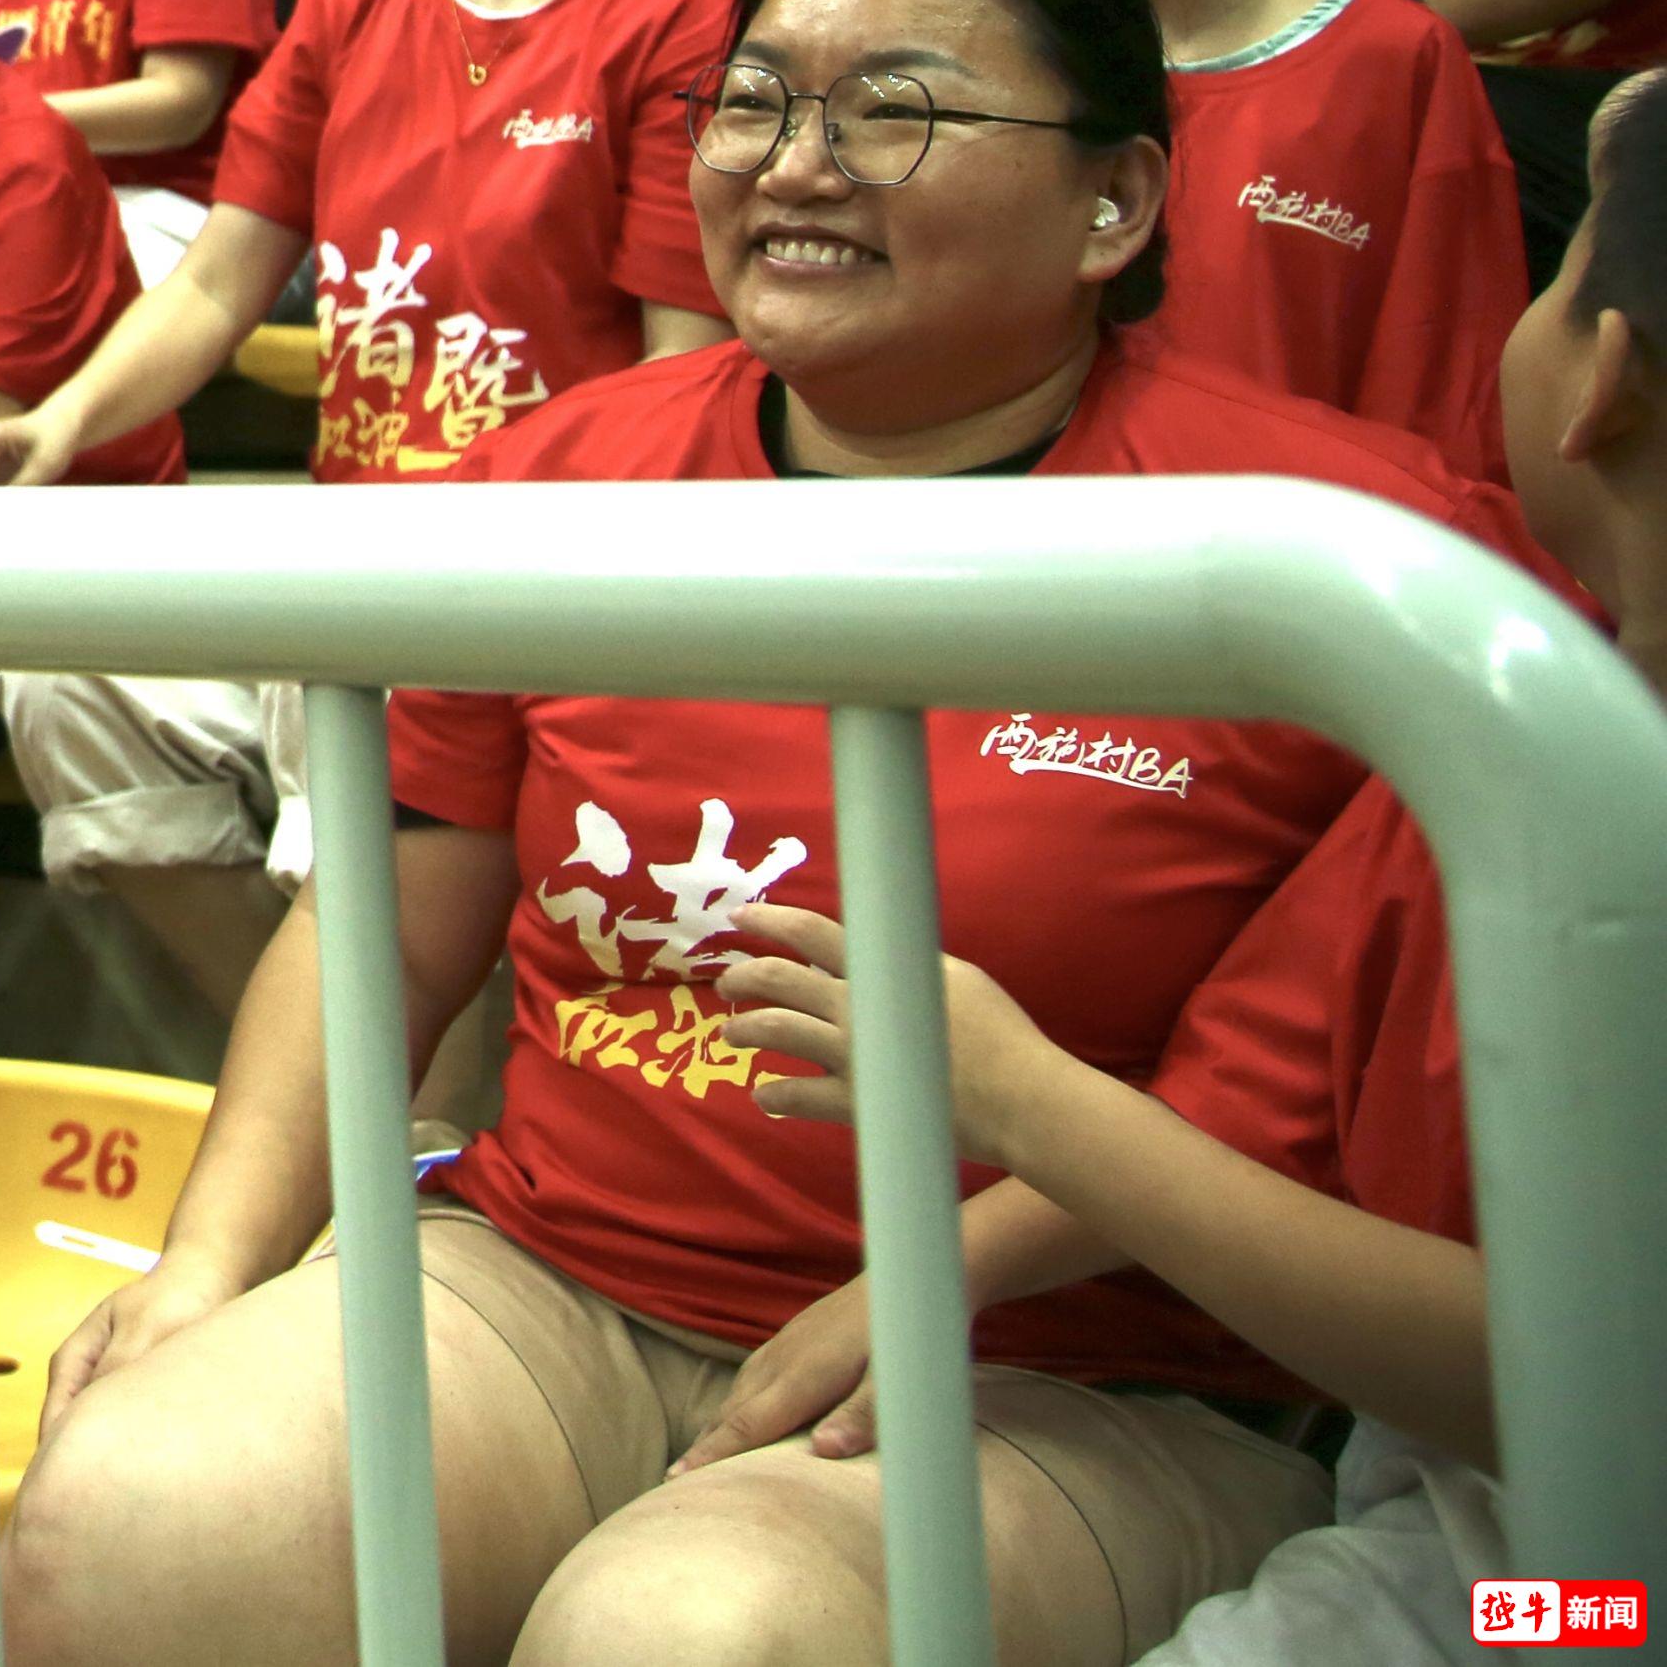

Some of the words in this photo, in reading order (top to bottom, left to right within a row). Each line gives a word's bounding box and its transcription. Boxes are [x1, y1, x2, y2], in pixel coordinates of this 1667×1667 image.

[979, 712, 1195, 799] 西施村BA
[40, 1119, 141, 1201] 26
